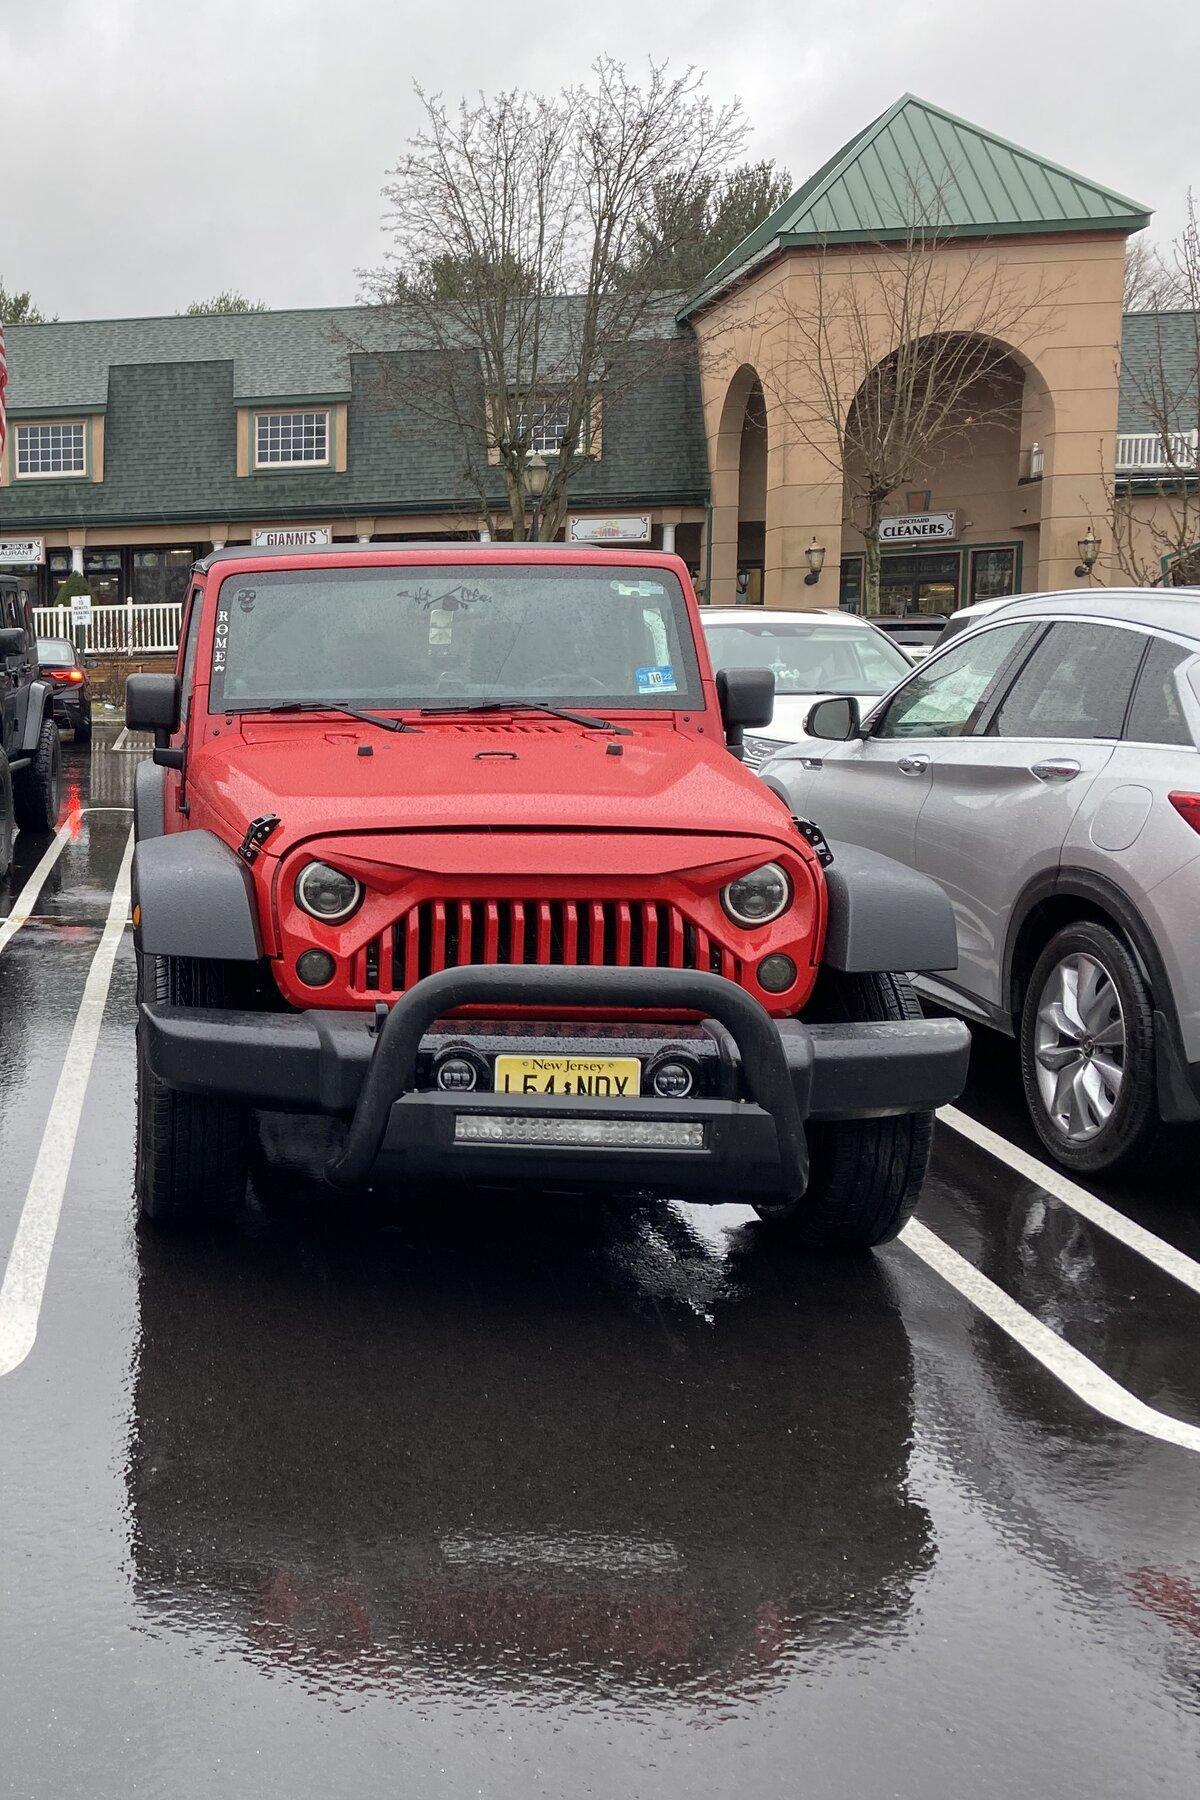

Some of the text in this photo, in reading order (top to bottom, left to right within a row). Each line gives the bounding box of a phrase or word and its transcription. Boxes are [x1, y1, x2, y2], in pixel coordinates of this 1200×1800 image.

[883, 523, 945, 537] CLEANERS
[531, 1059, 604, 1073] New Jersey
